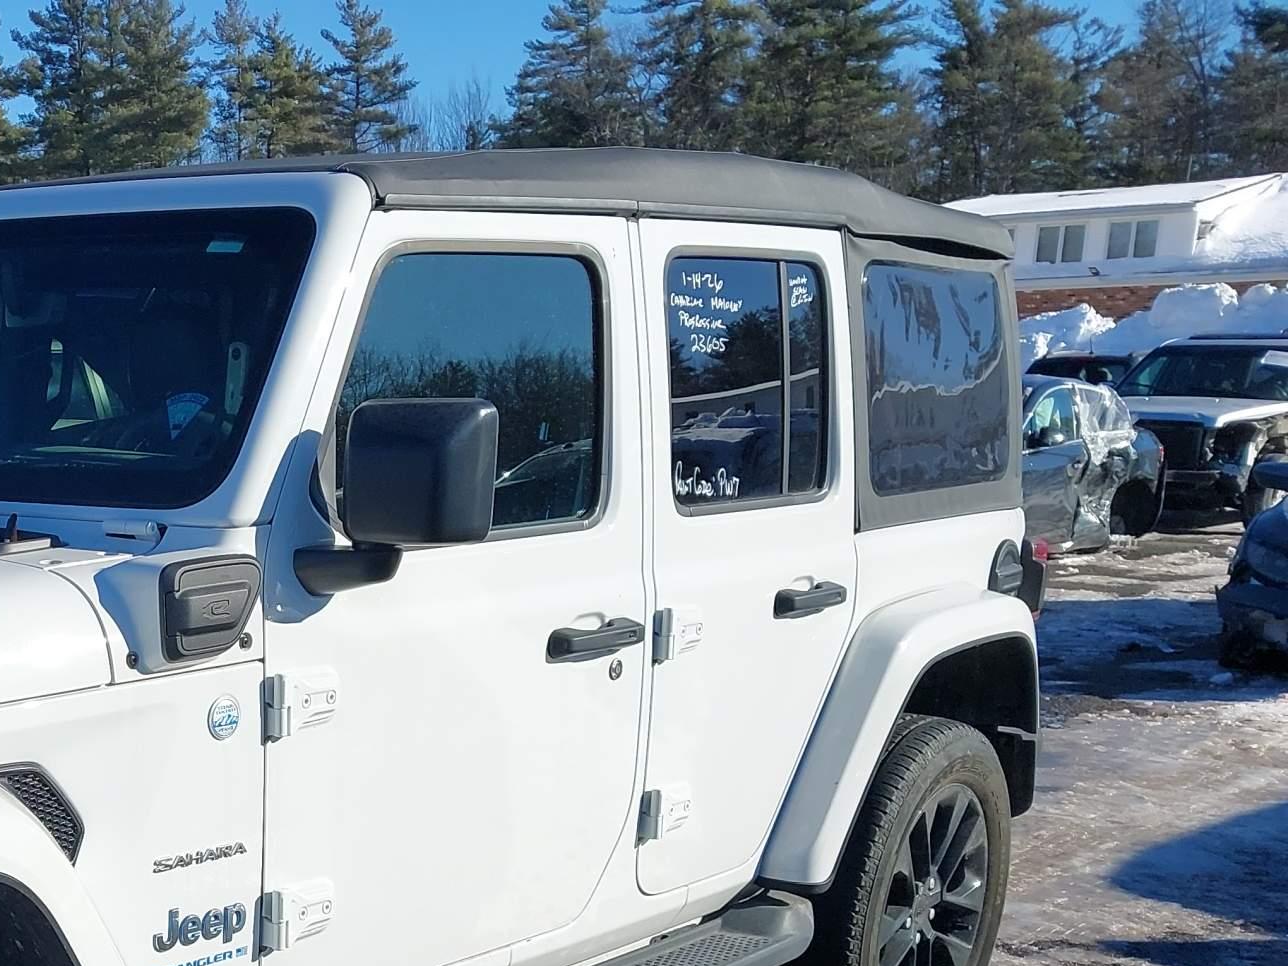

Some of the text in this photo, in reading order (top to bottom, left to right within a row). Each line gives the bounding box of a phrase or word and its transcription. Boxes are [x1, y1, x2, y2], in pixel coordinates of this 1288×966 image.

[682, 271, 724, 294] 1-14-26
[690, 334, 729, 353] 23605
[717, 467, 740, 497] PW7
[152, 842, 248, 874] SAHARA
[152, 902, 247, 954] Jeep
